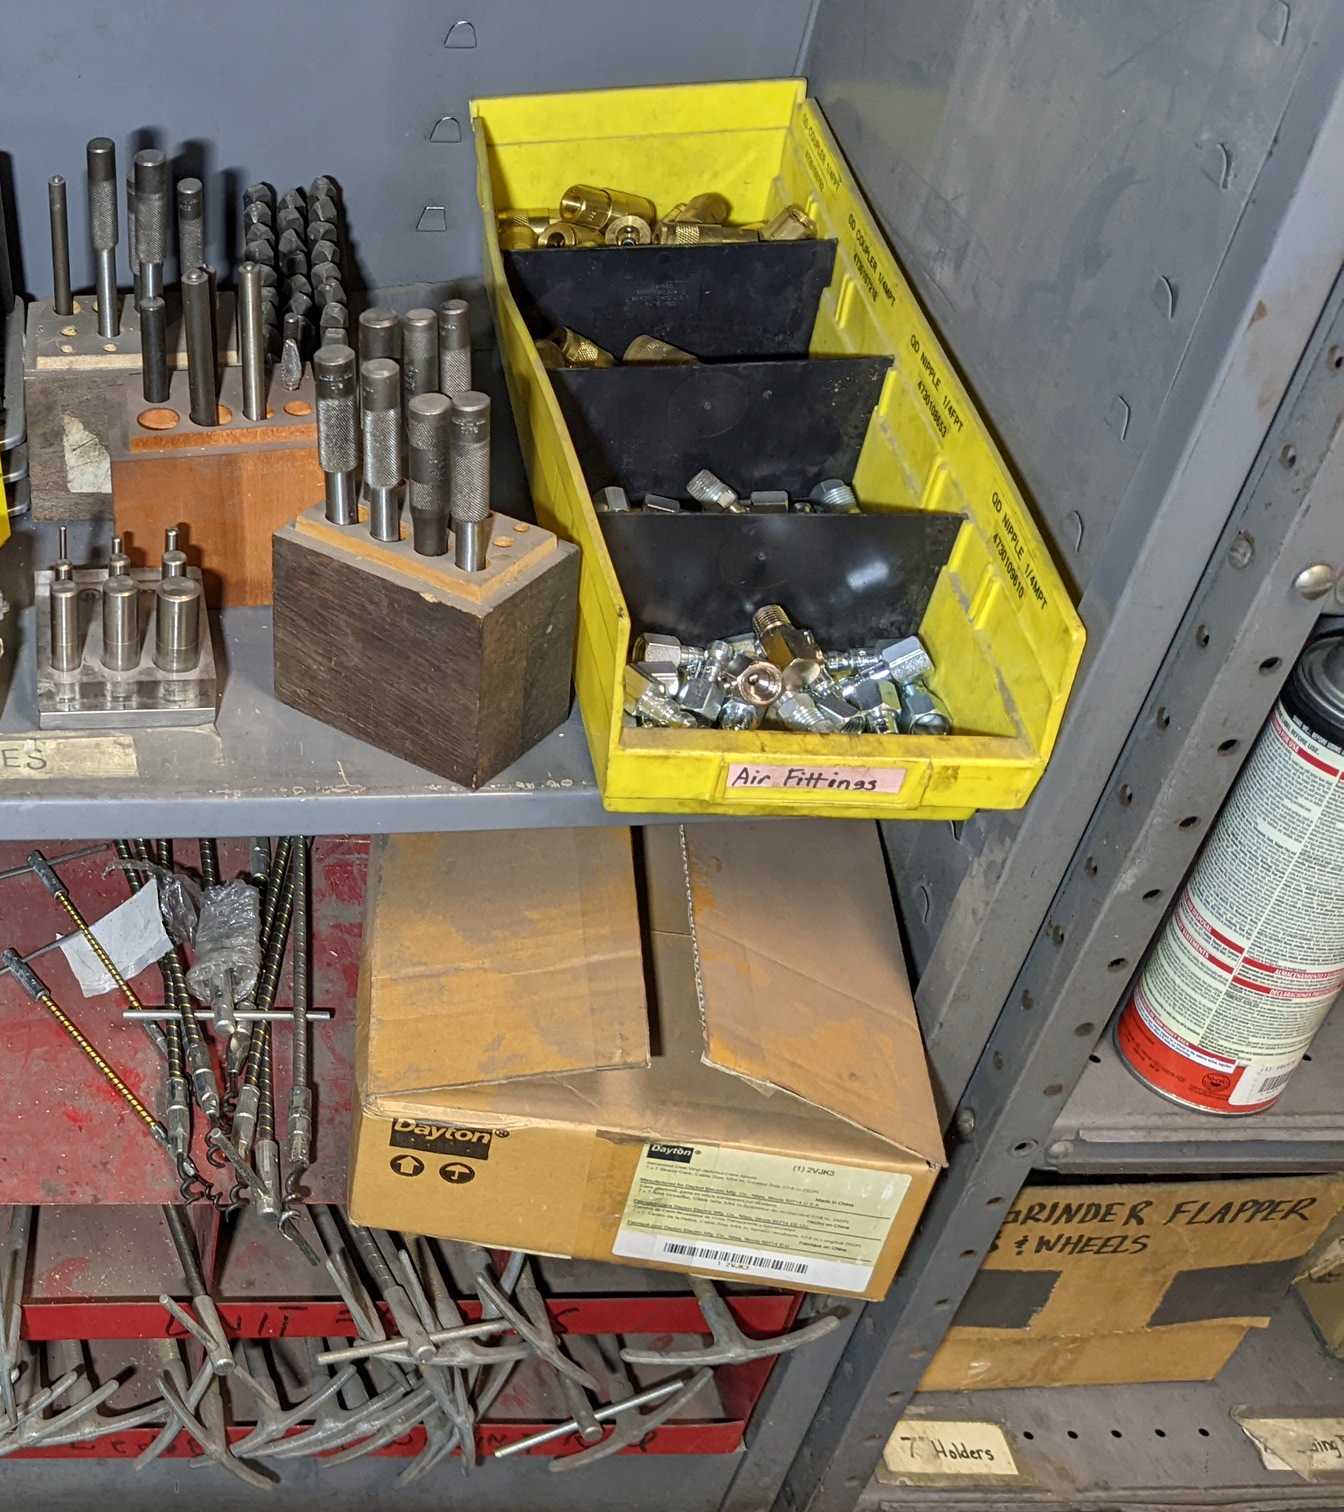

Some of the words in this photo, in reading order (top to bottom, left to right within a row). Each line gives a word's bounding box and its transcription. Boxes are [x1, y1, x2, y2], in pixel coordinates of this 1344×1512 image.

[856, 230, 877, 274] COUPLER
[910, 334, 920, 353] QD
[920, 351, 941, 392] NIPPLE
[943, 395, 963, 433] 1/4FPT
[992, 492, 1002, 514] QD
[1002, 514, 1024, 560] NIPPLE
[1025, 563, 1048, 610] 1/4MPT
[732, 767, 771, 786] Air
[784, 768, 877, 791] Fittings
[394, 1119, 491, 1144] Dayton
[650, 1145, 693, 1156] Dayton
[1163, 1197, 1317, 1225] FLAPPER
[1034, 1233, 1151, 1255] WHEELS
[930, 1439, 995, 1461] Holders
